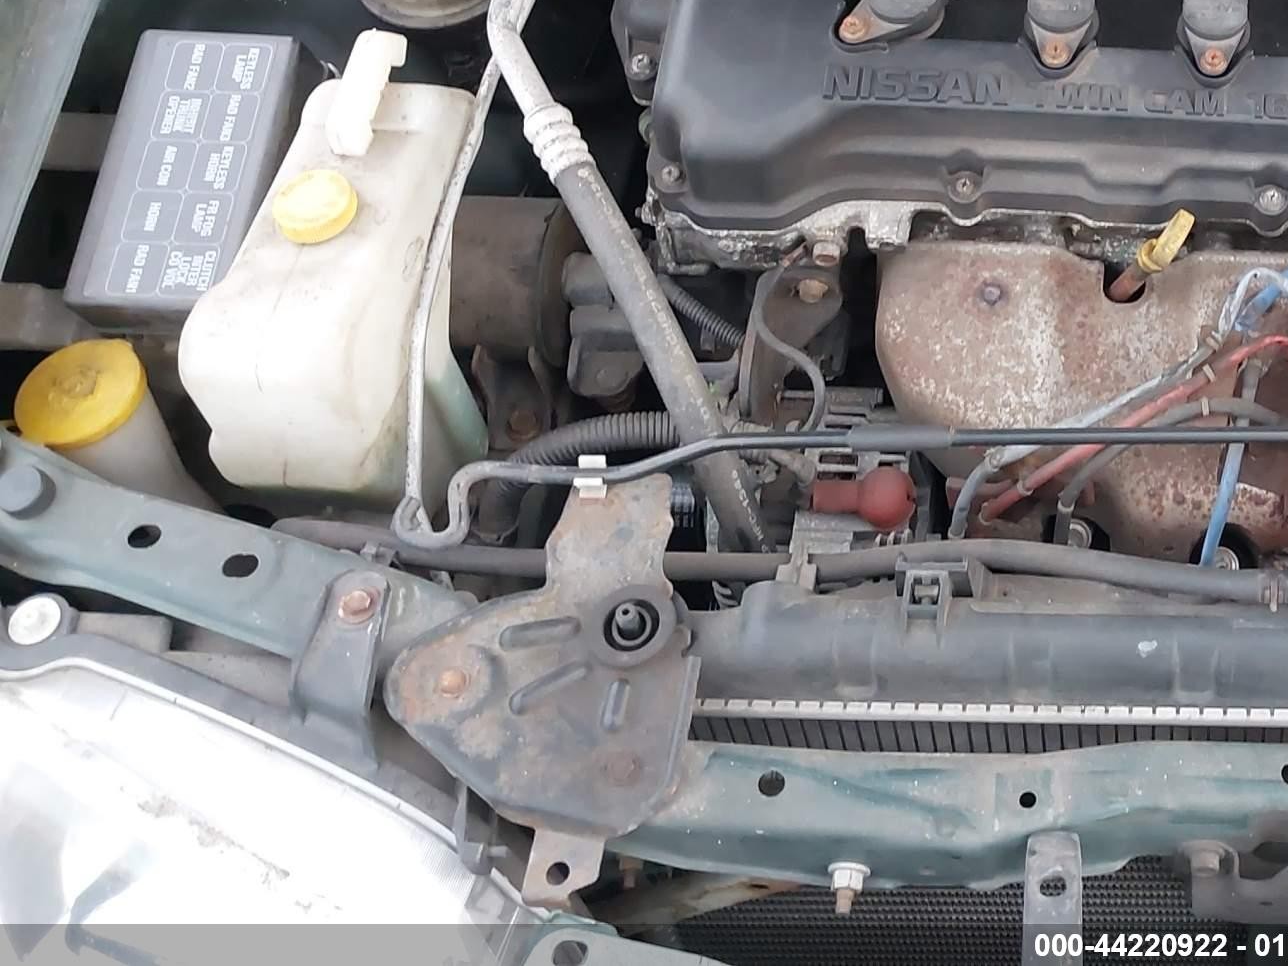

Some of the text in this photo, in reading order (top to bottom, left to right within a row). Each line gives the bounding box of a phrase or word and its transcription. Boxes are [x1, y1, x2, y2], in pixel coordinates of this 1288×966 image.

[184, 44, 206, 90] RAD FAN2
[240, 48, 260, 90] KEYLESS
[227, 94, 241, 114] RAD
[823, 65, 1008, 105] NISSAN
[1027, 82, 1128, 111] TWIN
[1144, 89, 1226, 117] CAM
[160, 95, 180, 134] OPENER
[213, 146, 234, 189] KEYLESS
[133, 245, 149, 266] RAD
[196, 251, 217, 291] CLUTCH
